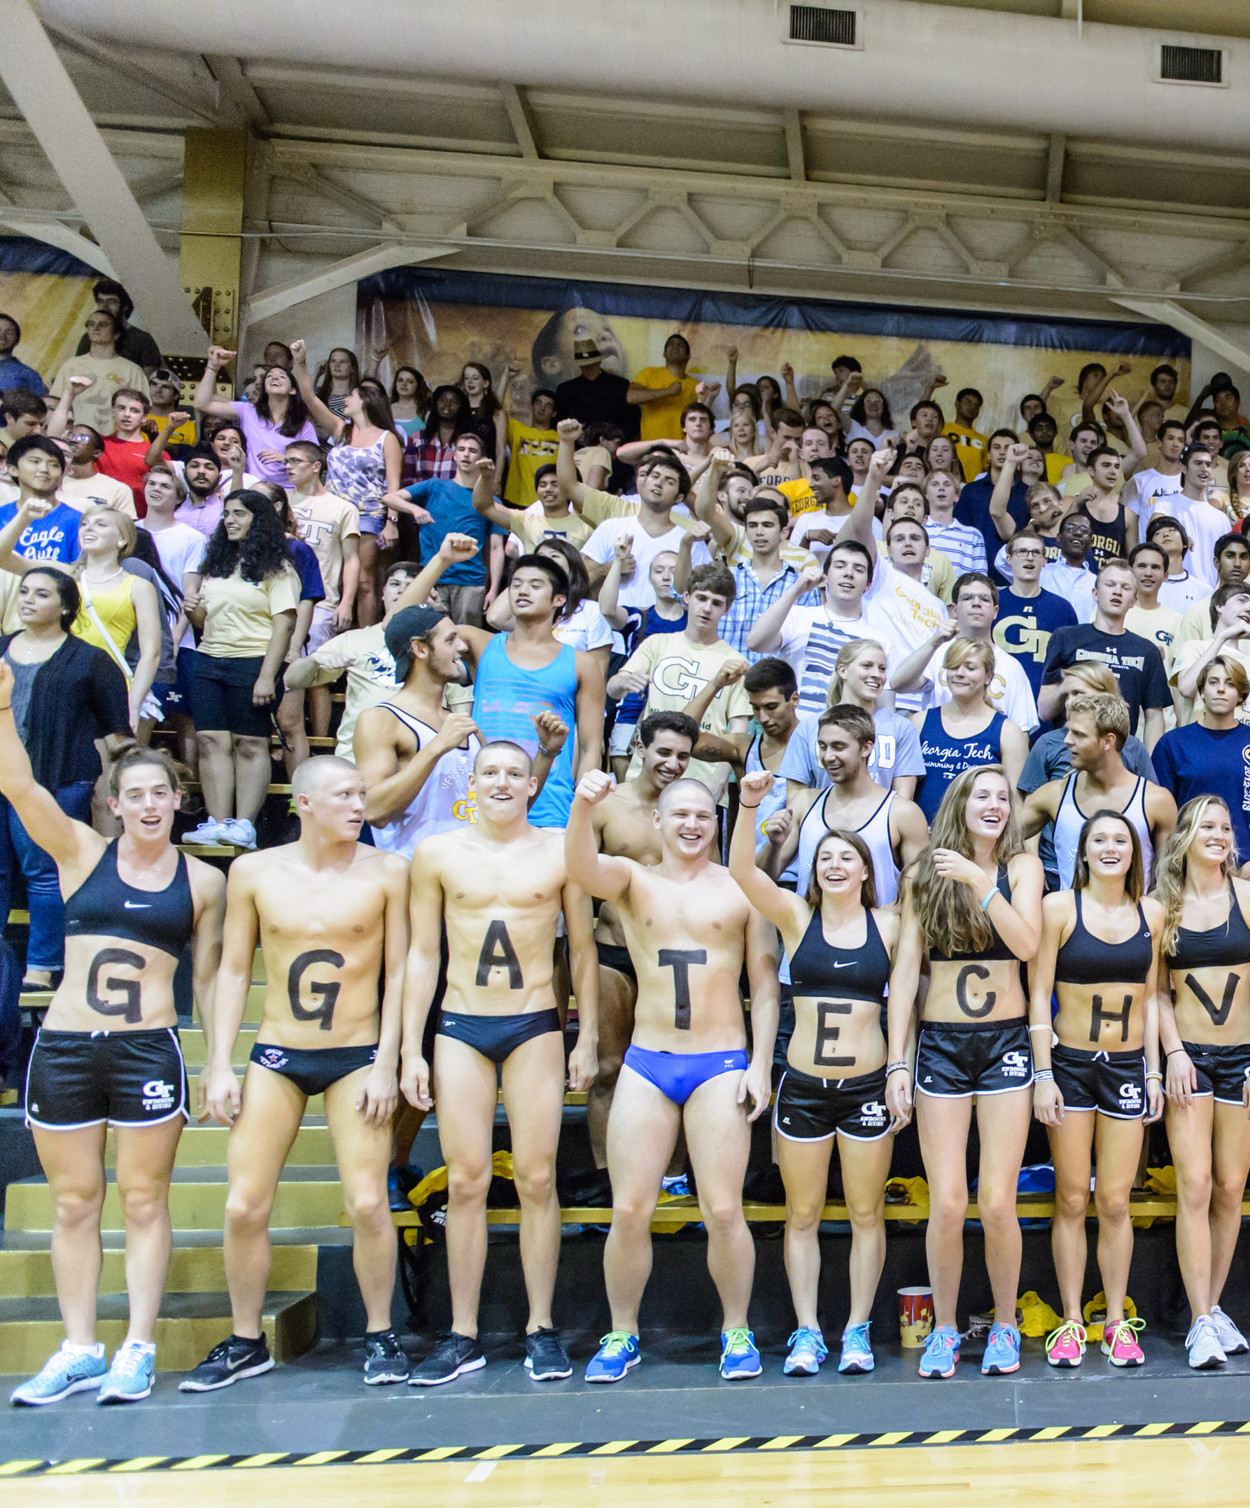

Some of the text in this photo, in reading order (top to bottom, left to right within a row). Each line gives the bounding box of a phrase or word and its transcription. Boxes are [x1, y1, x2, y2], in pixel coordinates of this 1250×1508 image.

[19, 526, 65, 548] Eagle
[963, 742, 994, 760] Tech
[475, 920, 524, 990] A
[86, 947, 147, 1024] G
[287, 949, 345, 1031] G
[658, 949, 708, 1030] T
[955, 964, 997, 1019] C
[1184, 972, 1241, 1026] V
[813, 1001, 856, 1067] E
[1089, 994, 1133, 1043] H
[1002, 1051, 1028, 1067] GT
[143, 1080, 174, 1098] GT
[861, 1101, 887, 1117] GT
[1119, 1083, 1141, 1099] GT
